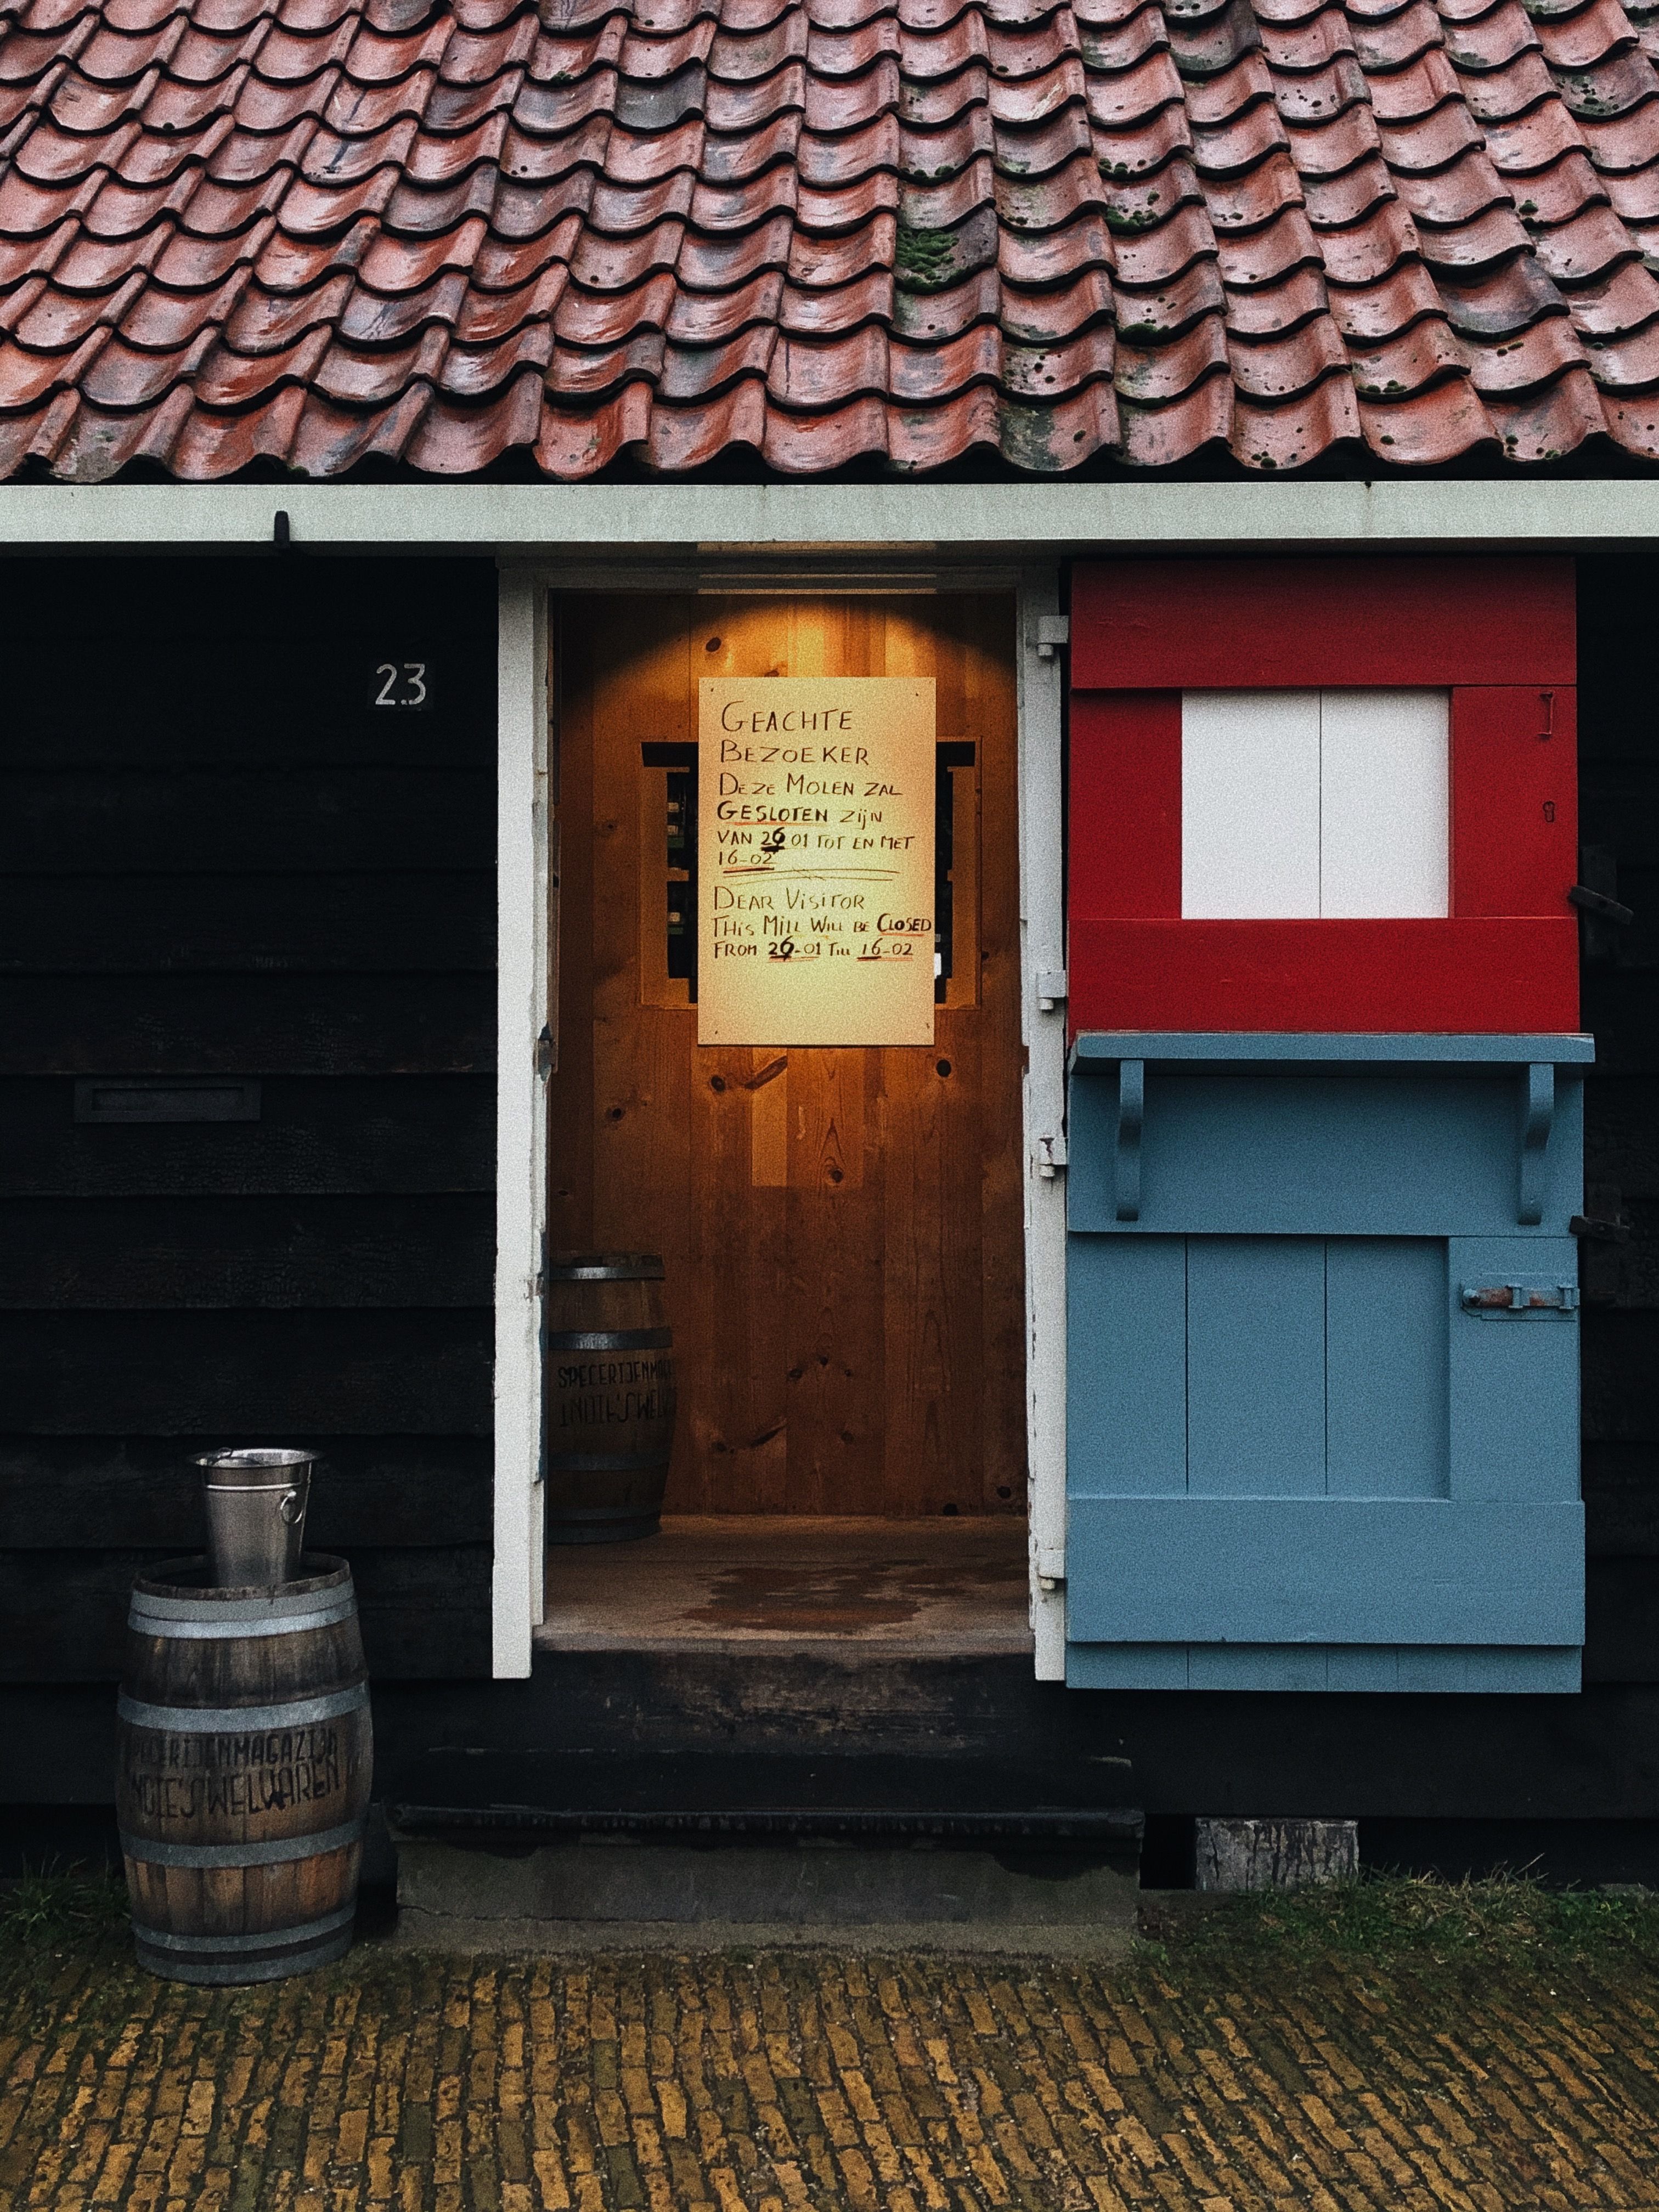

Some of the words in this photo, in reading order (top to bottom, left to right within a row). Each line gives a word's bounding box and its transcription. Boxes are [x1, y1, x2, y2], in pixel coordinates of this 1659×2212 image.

[375, 663, 426, 705] 23
[721, 701, 853, 732] GEACHTE
[720, 739, 869, 765] BEZOEKER
[719, 772, 776, 795] DEZE
[786, 772, 854, 795] MOLEN
[864, 782, 903, 796] ZAL
[717, 800, 828, 822] GESLOTEN
[718, 830, 752, 845] VAN
[817, 834, 848, 849] TOT
[852, 836, 873, 850] EN
[881, 835, 915, 850] MET
[714, 886, 774, 911] DEAR
[854, 921, 870, 933] BE
[877, 913, 932, 932] CLOSED
[714, 941, 757, 958] FROM
[862, 938, 913, 956] 16-02
